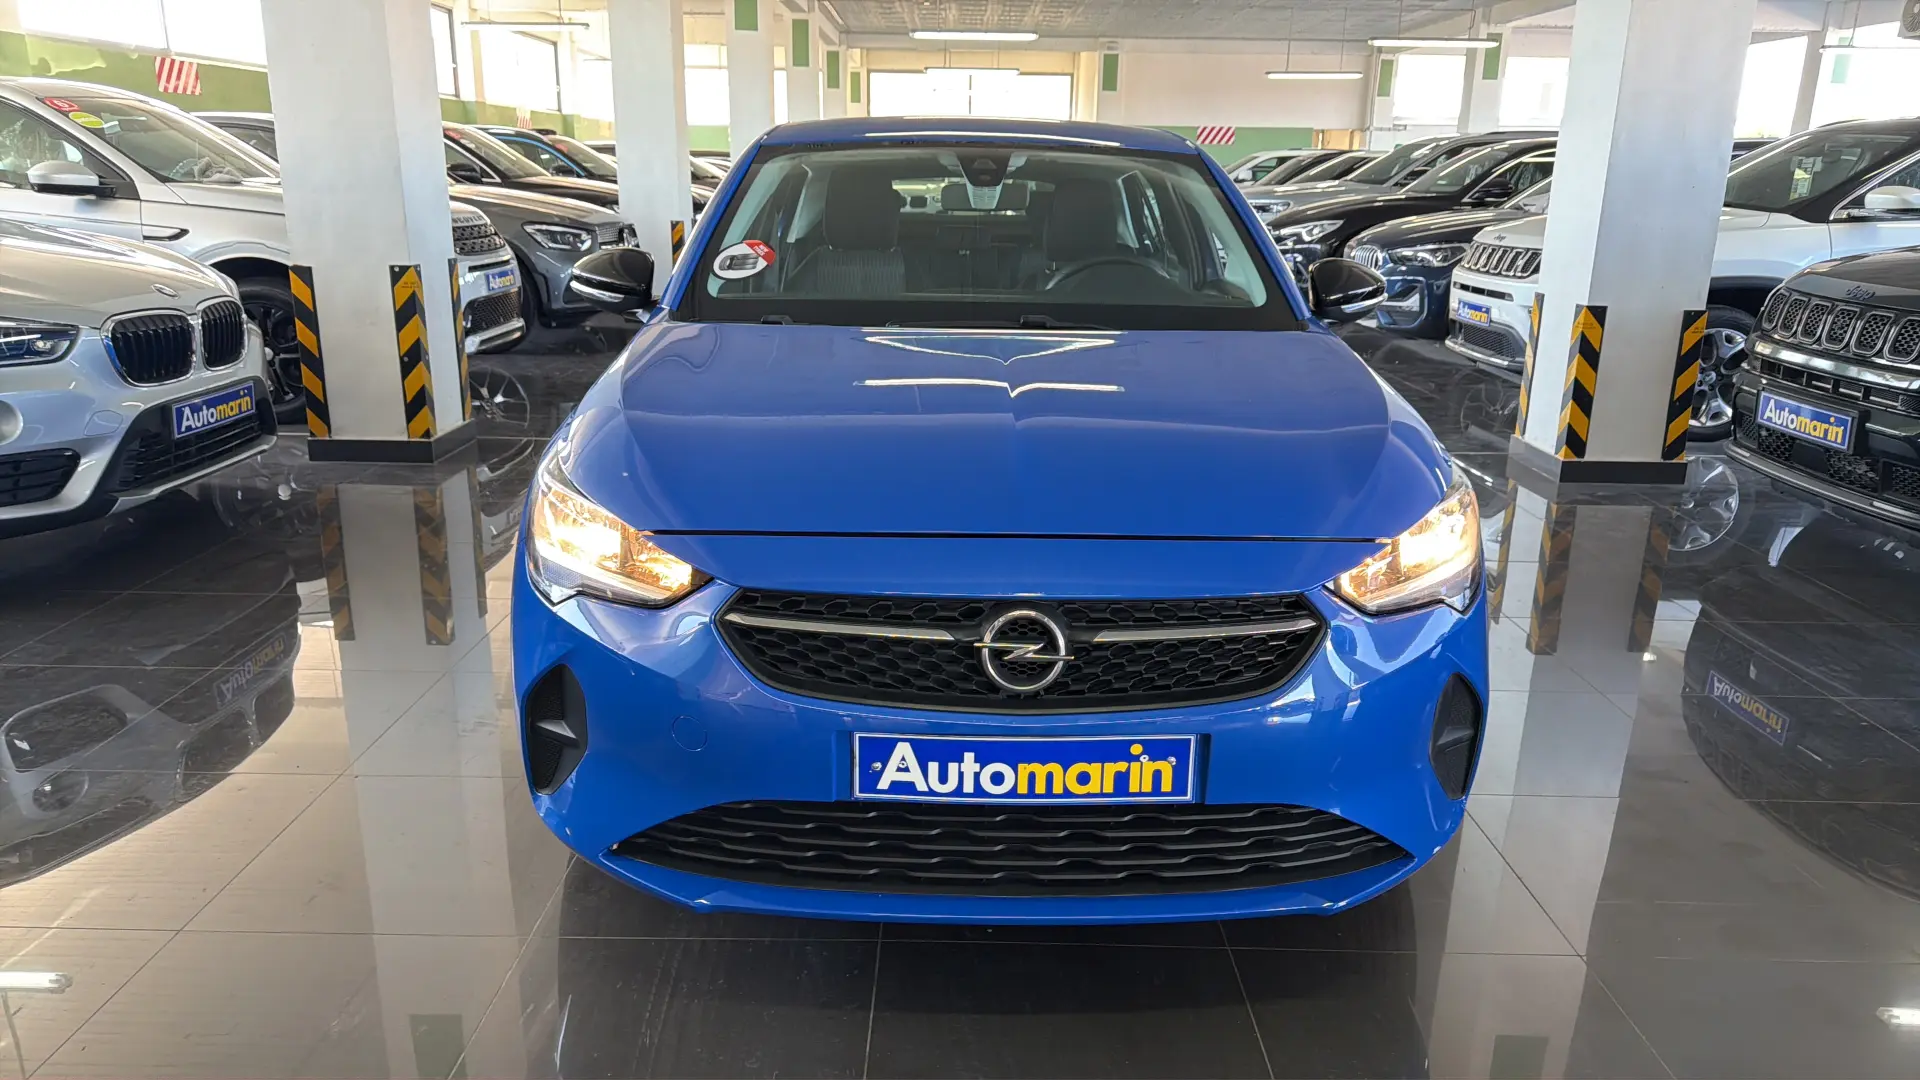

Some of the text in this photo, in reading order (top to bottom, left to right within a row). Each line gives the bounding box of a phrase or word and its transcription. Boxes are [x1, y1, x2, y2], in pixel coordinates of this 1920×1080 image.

[1846, 285, 1876, 299] Jeep
[181, 390, 252, 432] Automarin
[1763, 399, 1844, 444] Automarin
[876, 741, 1172, 794] Automarin
